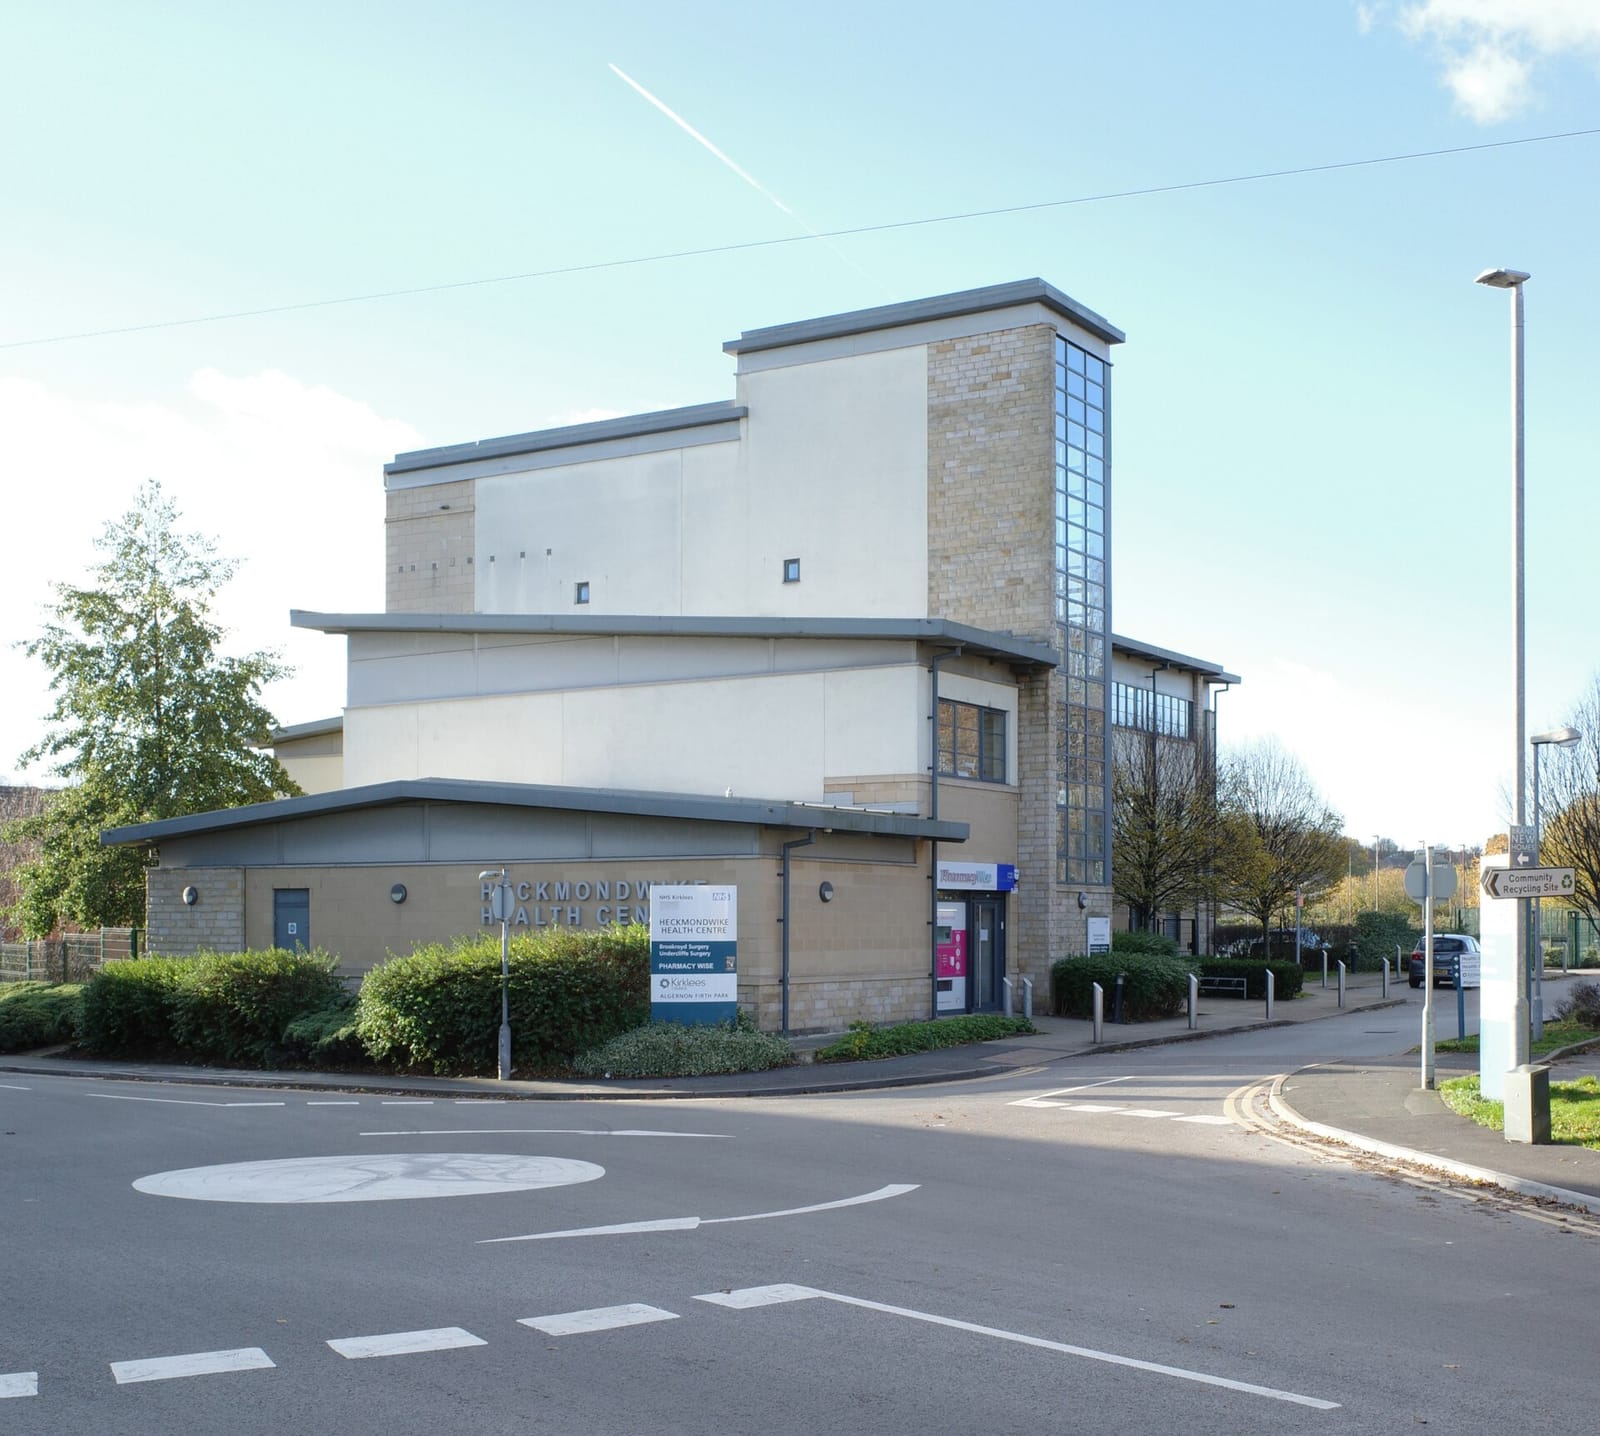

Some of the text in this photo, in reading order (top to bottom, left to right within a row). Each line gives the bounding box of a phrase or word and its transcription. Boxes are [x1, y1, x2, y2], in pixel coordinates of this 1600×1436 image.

[1512, 834, 1536, 844] NEW
[1508, 873, 1553, 883] Community
[481, 880, 706, 901] HCKMONDW
[1503, 883, 1559, 895] Recycling Site
[481, 906, 581, 925] HALTH
[671, 978, 706, 987] Kirklees
